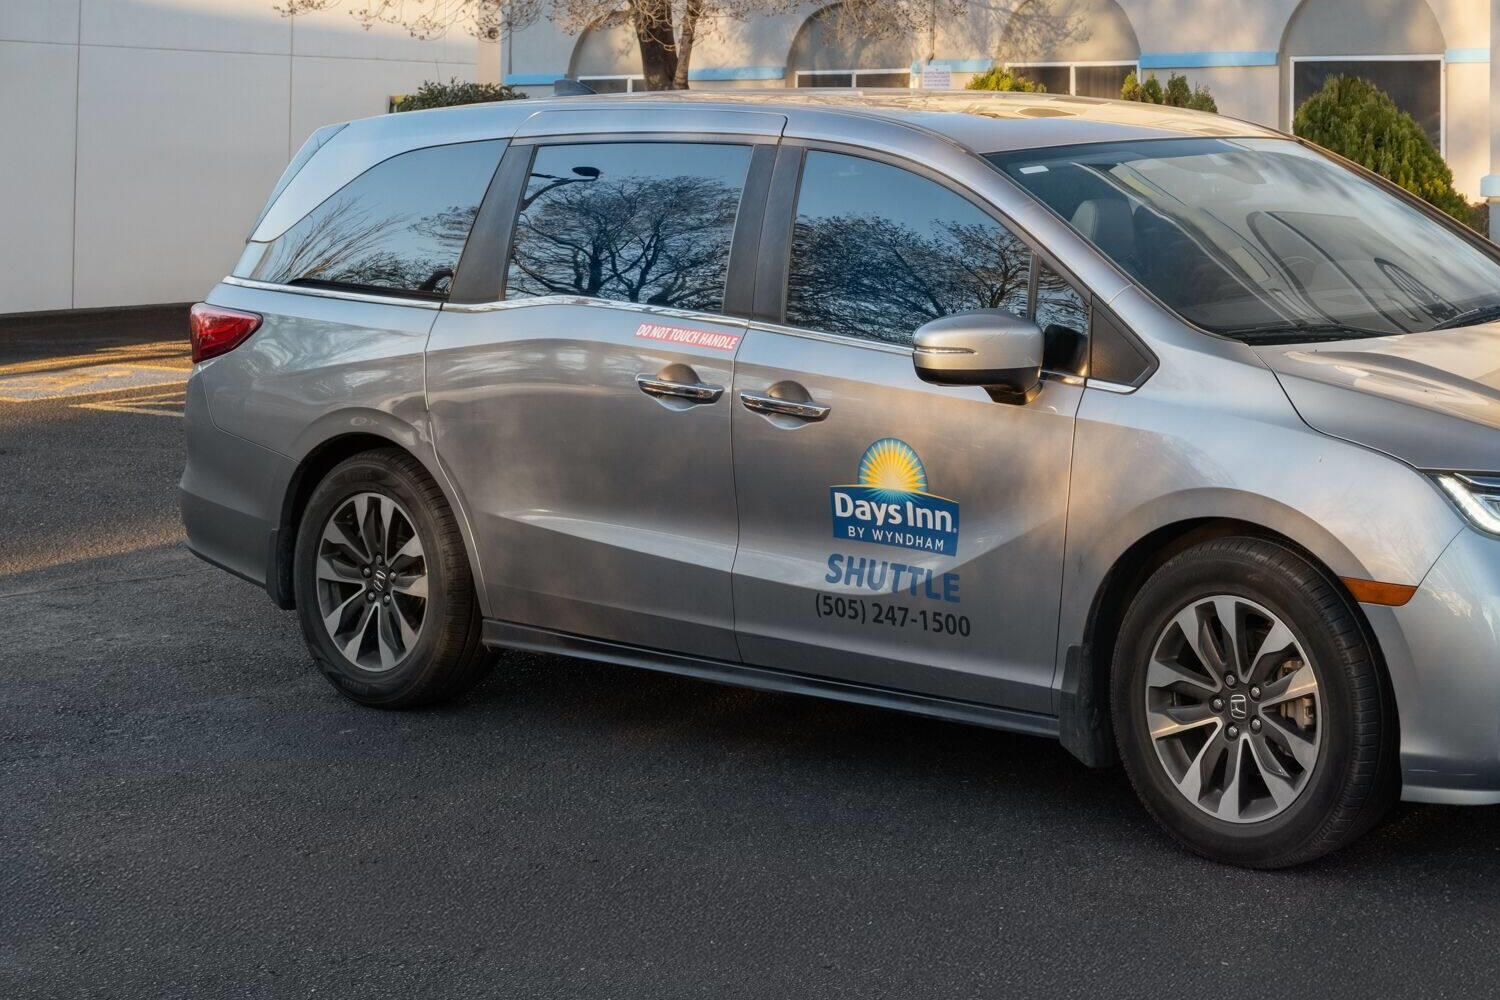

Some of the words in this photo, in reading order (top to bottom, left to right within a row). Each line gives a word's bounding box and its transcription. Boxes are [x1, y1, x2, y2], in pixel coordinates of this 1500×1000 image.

[636, 324, 651, 337] DO
[649, 325, 672, 339] NOT
[669, 328, 700, 343] TOUCH
[698, 332, 738, 349] HANDLE
[834, 491, 901, 526] Days
[906, 501, 953, 533] Inn
[847, 525, 865, 538] BY
[872, 529, 945, 552] WYNDHAM
[825, 553, 961, 604] SHUTTLE
[815, 593, 866, 624] (505)
[872, 602, 971, 638] 247-1500
